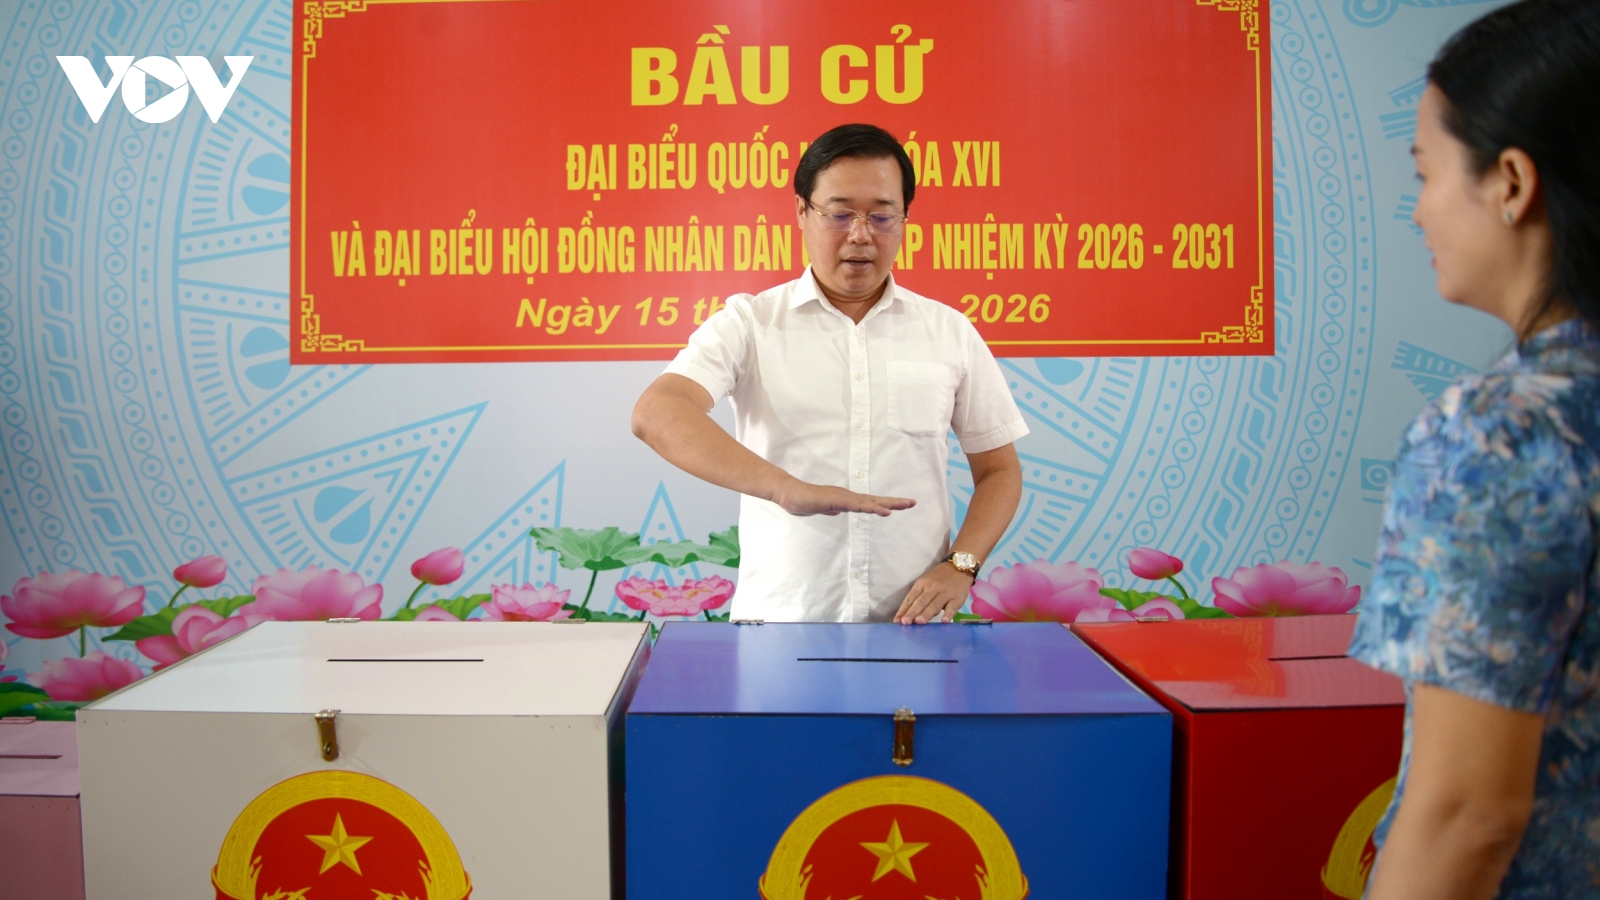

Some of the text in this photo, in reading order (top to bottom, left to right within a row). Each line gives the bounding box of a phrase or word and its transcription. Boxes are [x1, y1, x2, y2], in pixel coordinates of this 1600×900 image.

[630, 23, 934, 107] BẦU CỬ
[566, 143, 617, 201] ĐẠI
[627, 123, 697, 190] BIỂU
[707, 124, 790, 195] QUỐC
[952, 140, 1001, 187] XVI
[330, 220, 367, 277] VÀ
[373, 229, 421, 287] ĐẠI
[429, 208, 493, 276] BIỂU
[502, 217, 549, 285] HỘI
[556, 210, 636, 274] ĐỒNG
[644, 215, 725, 273] NHÂN
[733, 214, 792, 272] DÂN
[932, 212, 1025, 281] NHIỆM
[1033, 212, 1069, 270] KỲ
[1077, 223, 1144, 270] 2026
[1153, 244, 1163, 254] -
[1172, 223, 1234, 270] 2031
[515, 296, 622, 336] Ngày
[634, 296, 681, 327] 15
[960, 293, 1051, 324] 2026
